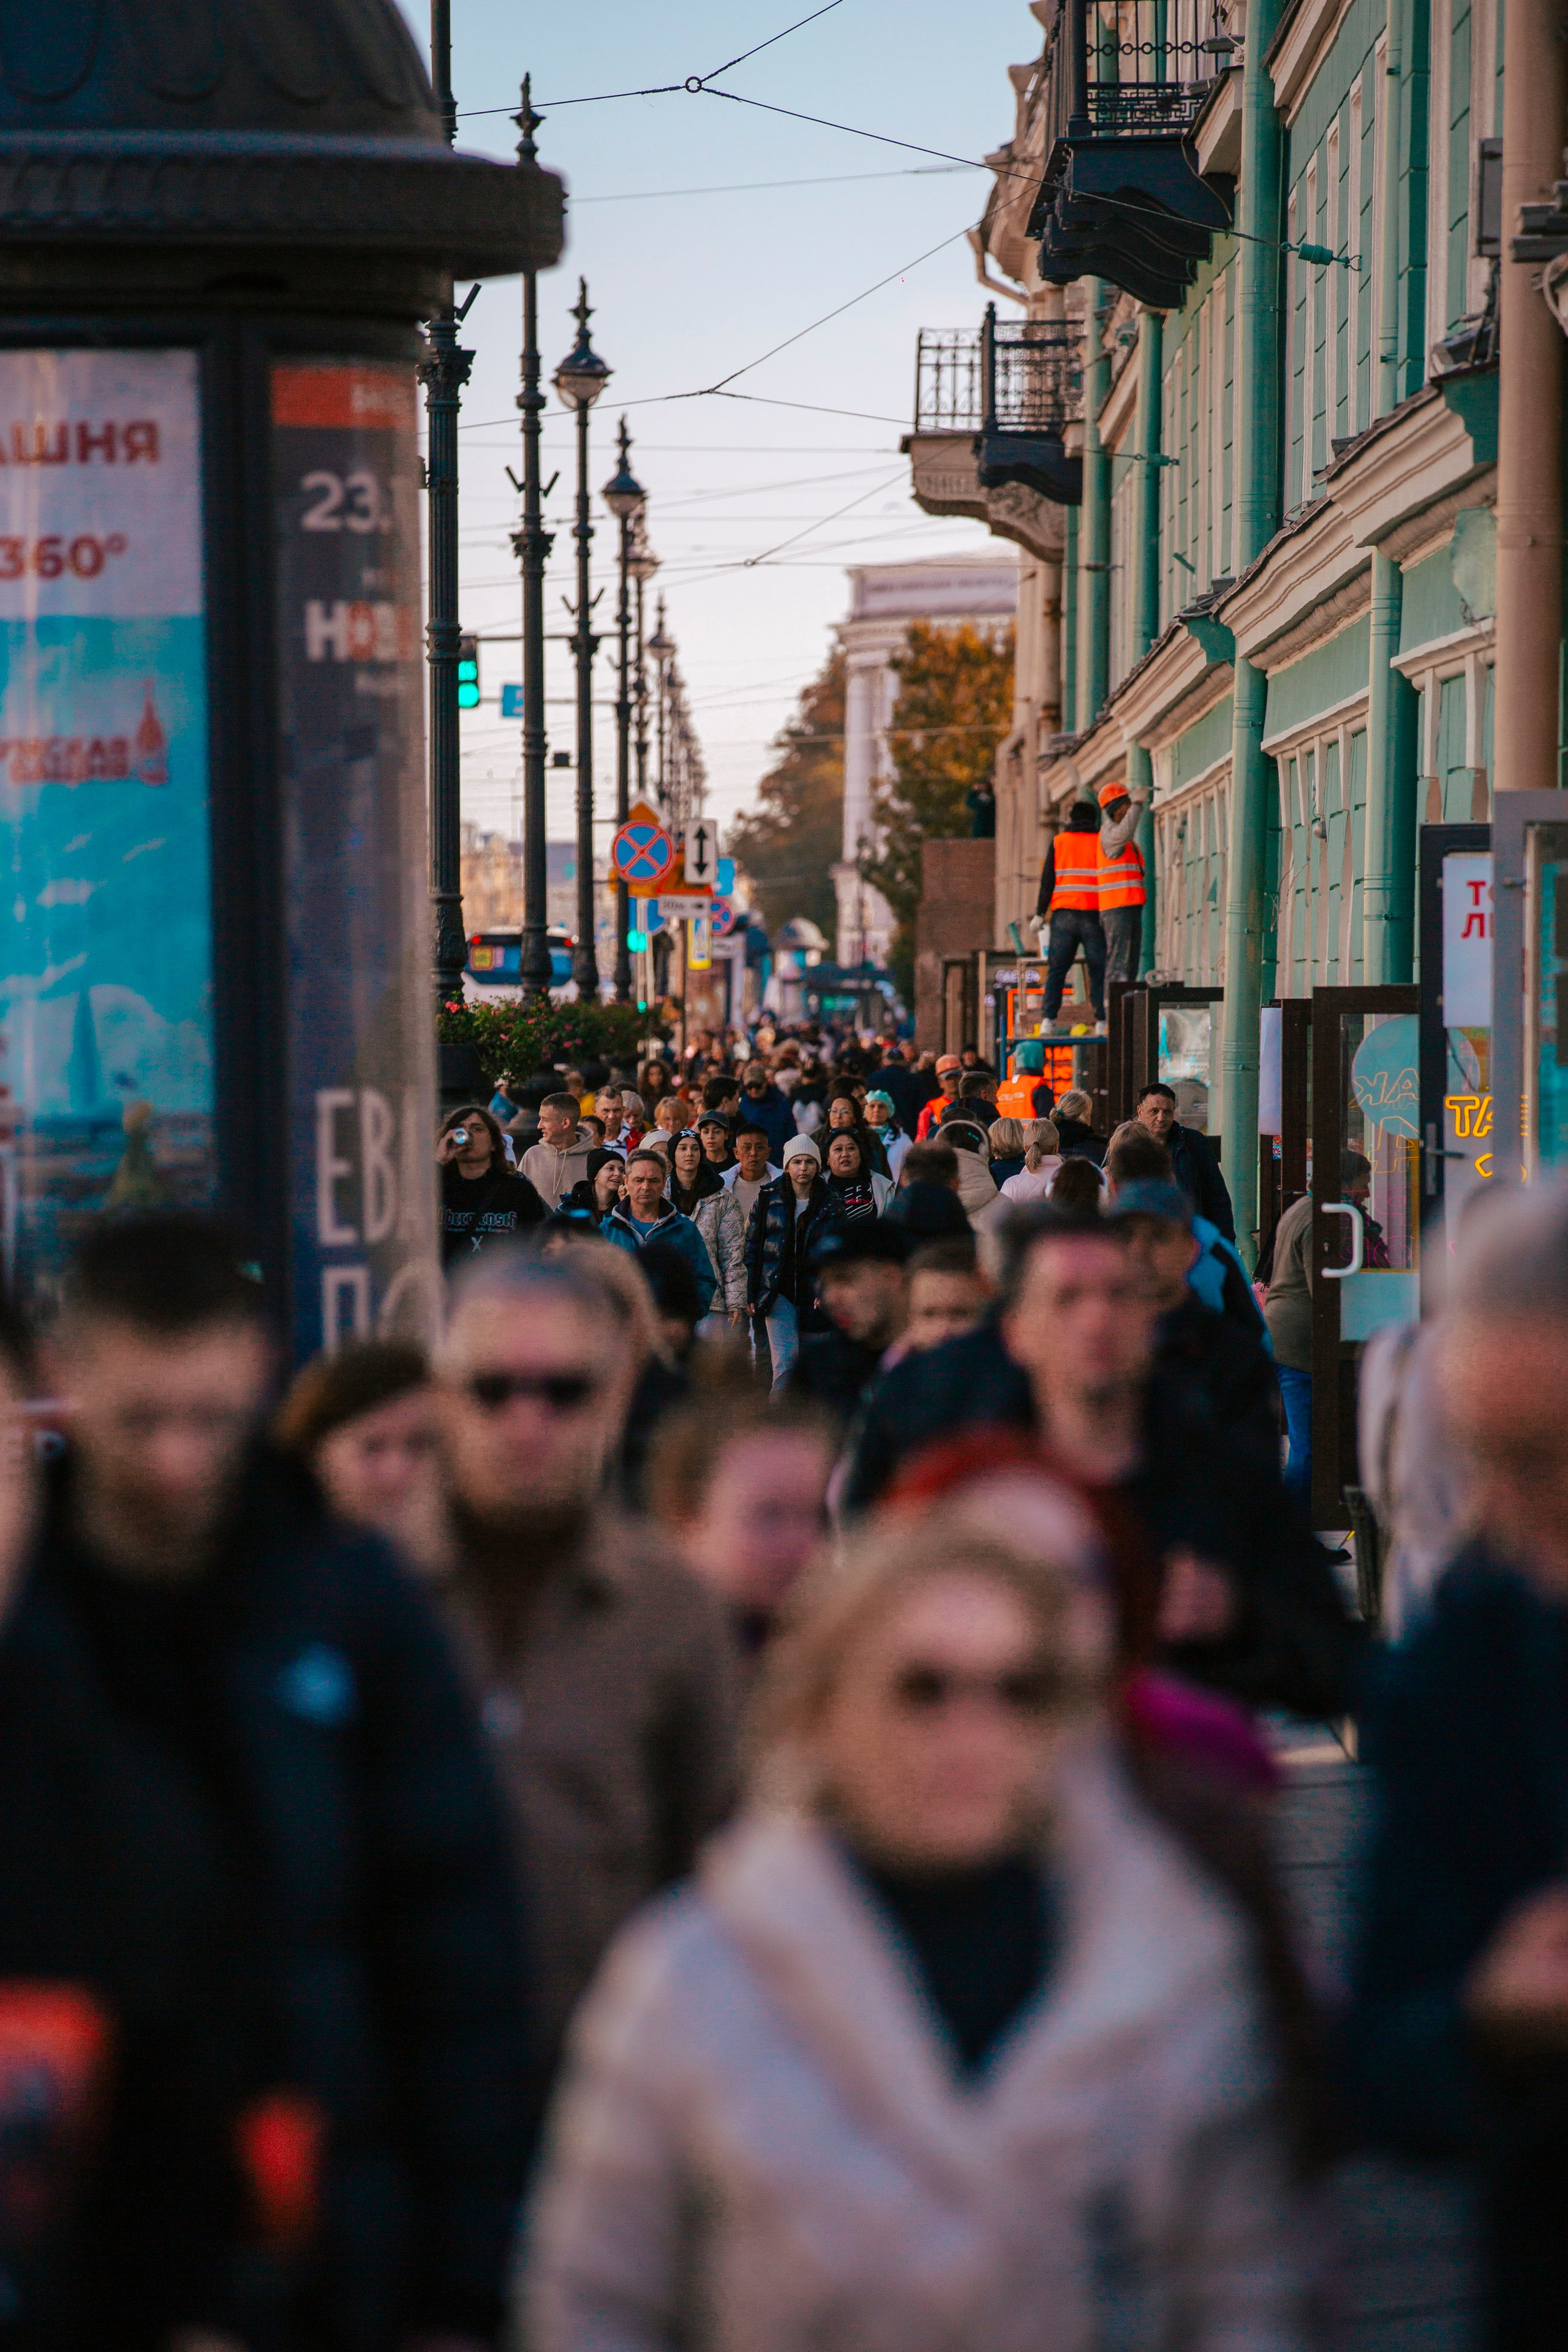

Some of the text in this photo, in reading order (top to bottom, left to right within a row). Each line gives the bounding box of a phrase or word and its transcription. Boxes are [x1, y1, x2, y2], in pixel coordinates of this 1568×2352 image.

[0, 419, 160, 466] ШНЯ
[1466, 880, 1494, 907] Т
[1460, 913, 1494, 939] Л
